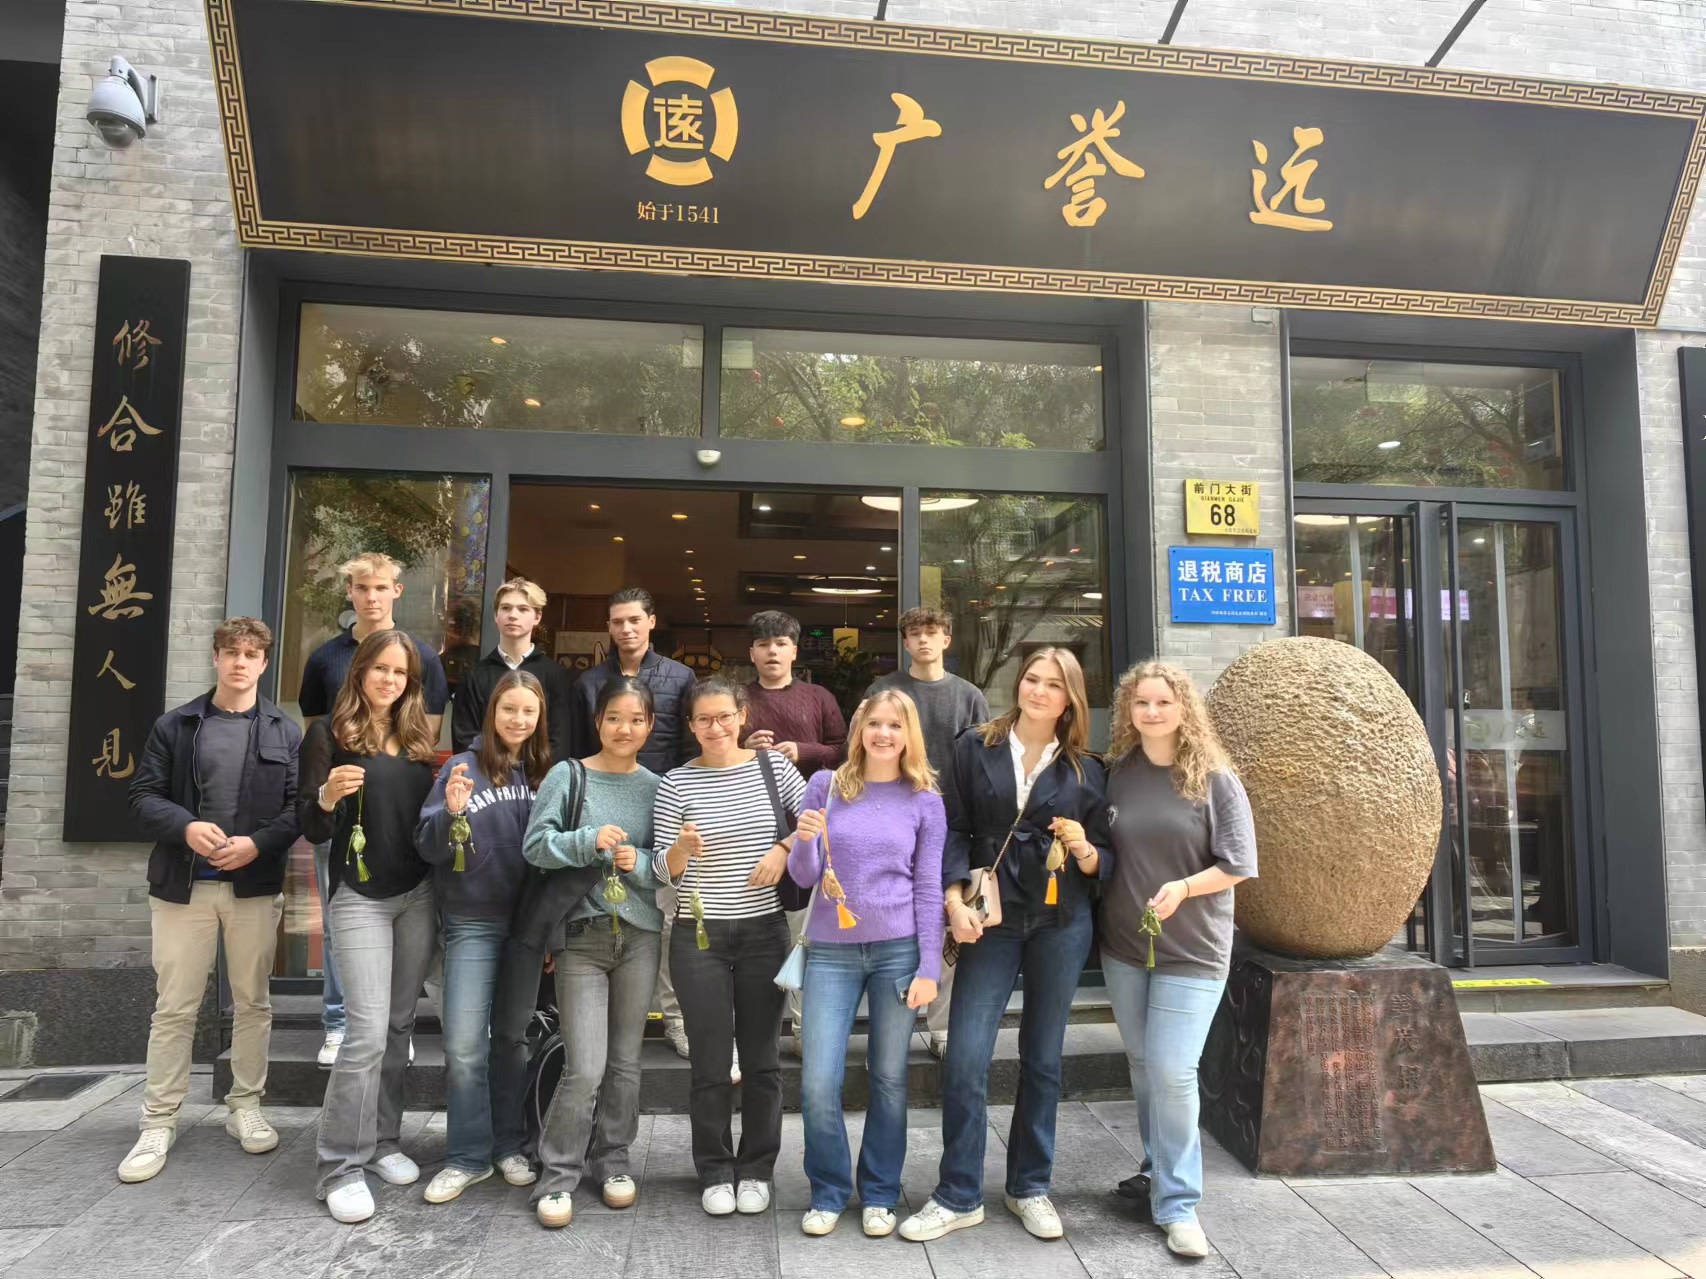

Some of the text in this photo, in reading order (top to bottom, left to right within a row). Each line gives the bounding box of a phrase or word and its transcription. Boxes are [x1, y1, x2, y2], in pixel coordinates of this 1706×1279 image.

[852, 92, 1333, 231] 广誉远
[638, 201, 720, 224] 始于1541
[1194, 482, 1252, 496] 前门大街
[1210, 503, 1236, 526] 68
[88, 319, 163, 779] 修合雖無人見
[1178, 560, 1267, 584] 退税商店
[1178, 588, 1267, 603] TAX FREE
[467, 787, 497, 813] SAN
